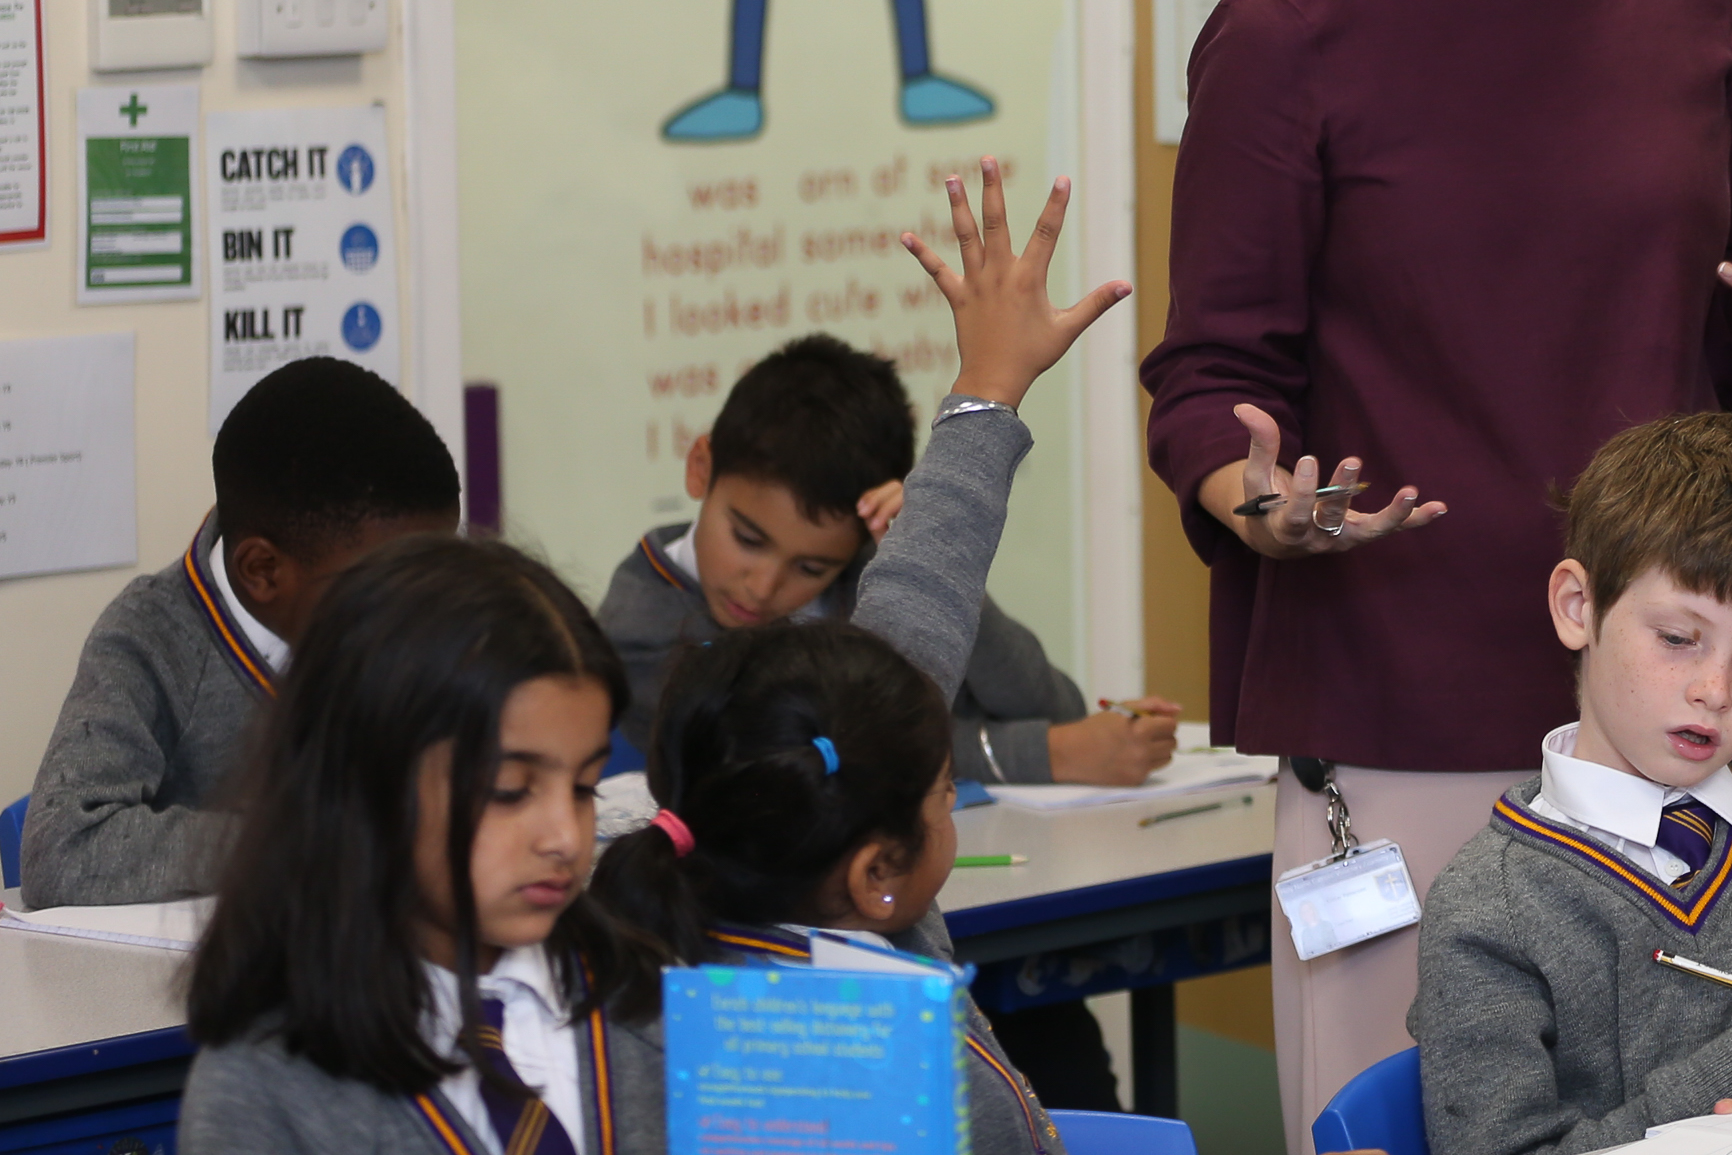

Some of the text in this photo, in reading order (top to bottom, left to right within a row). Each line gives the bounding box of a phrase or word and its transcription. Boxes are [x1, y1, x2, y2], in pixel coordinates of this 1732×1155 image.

[220, 147, 329, 183] CATCH IT
[222, 227, 294, 262] BIN IT
[224, 306, 305, 343] KILL IT
